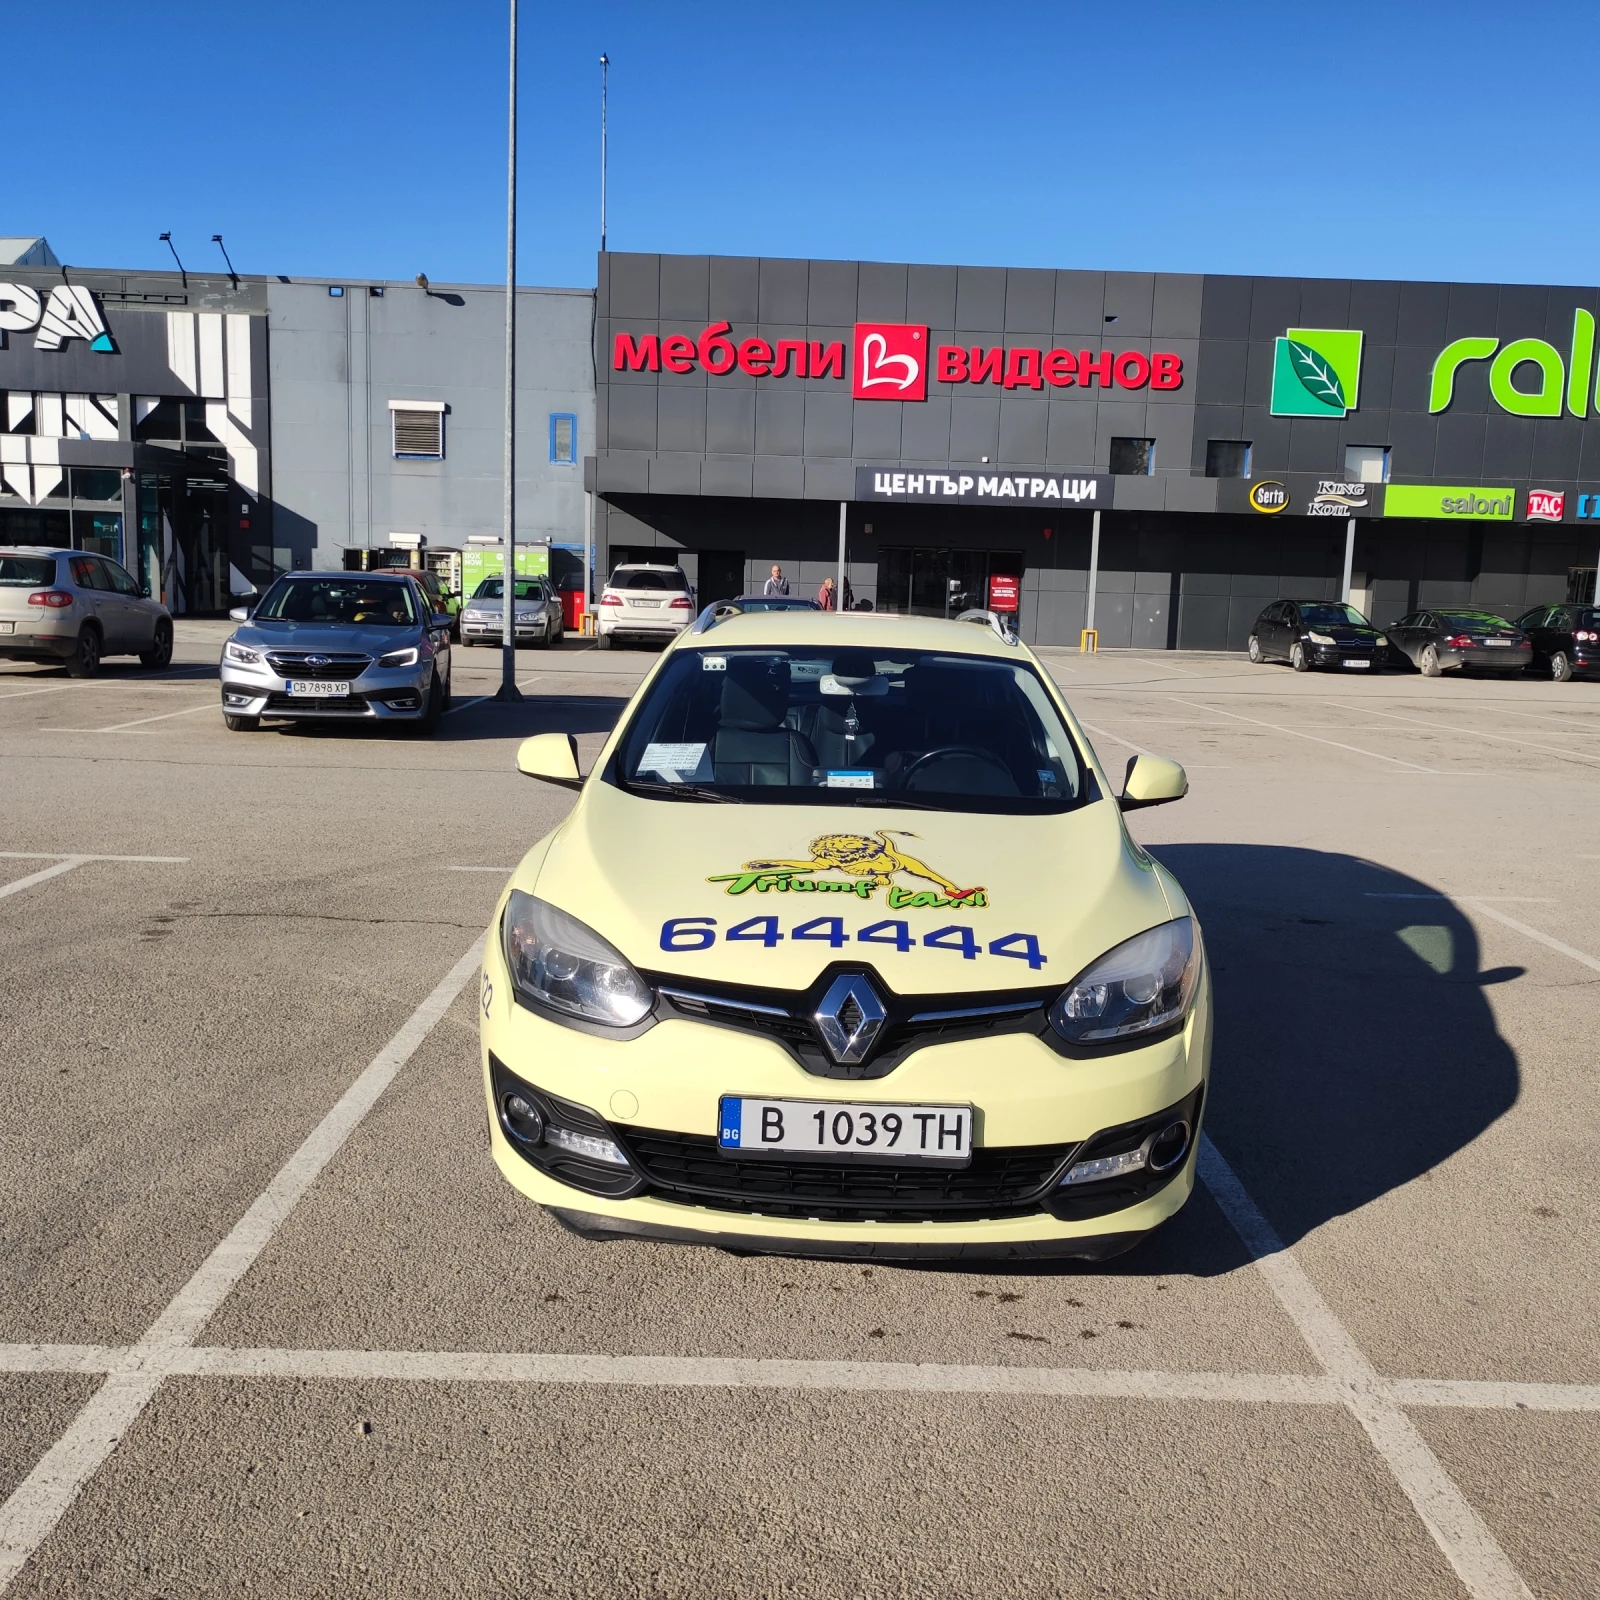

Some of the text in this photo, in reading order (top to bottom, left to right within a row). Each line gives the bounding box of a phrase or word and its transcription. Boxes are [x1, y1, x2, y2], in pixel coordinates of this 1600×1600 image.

[613, 321, 843, 378] мебели
[937, 345, 1182, 389] виденов
[1428, 307, 1600, 418] ral
[874, 473, 1097, 502] ЦЕНТЪР МАТРАЦИ
[1257, 487, 1284, 504] Serta
[1440, 493, 1512, 515] saloni
[1530, 496, 1562, 517] TAÇ
[464, 552, 481, 560] BOX
[293, 682, 307, 692] CB
[308, 683, 333, 693] 7898
[334, 683, 348, 693] XP
[708, 868, 988, 909] Triumf taxi
[659, 915, 1048, 970] 644444
[722, 1128, 739, 1140] BG
[761, 1106, 963, 1151] B 1039 TH
